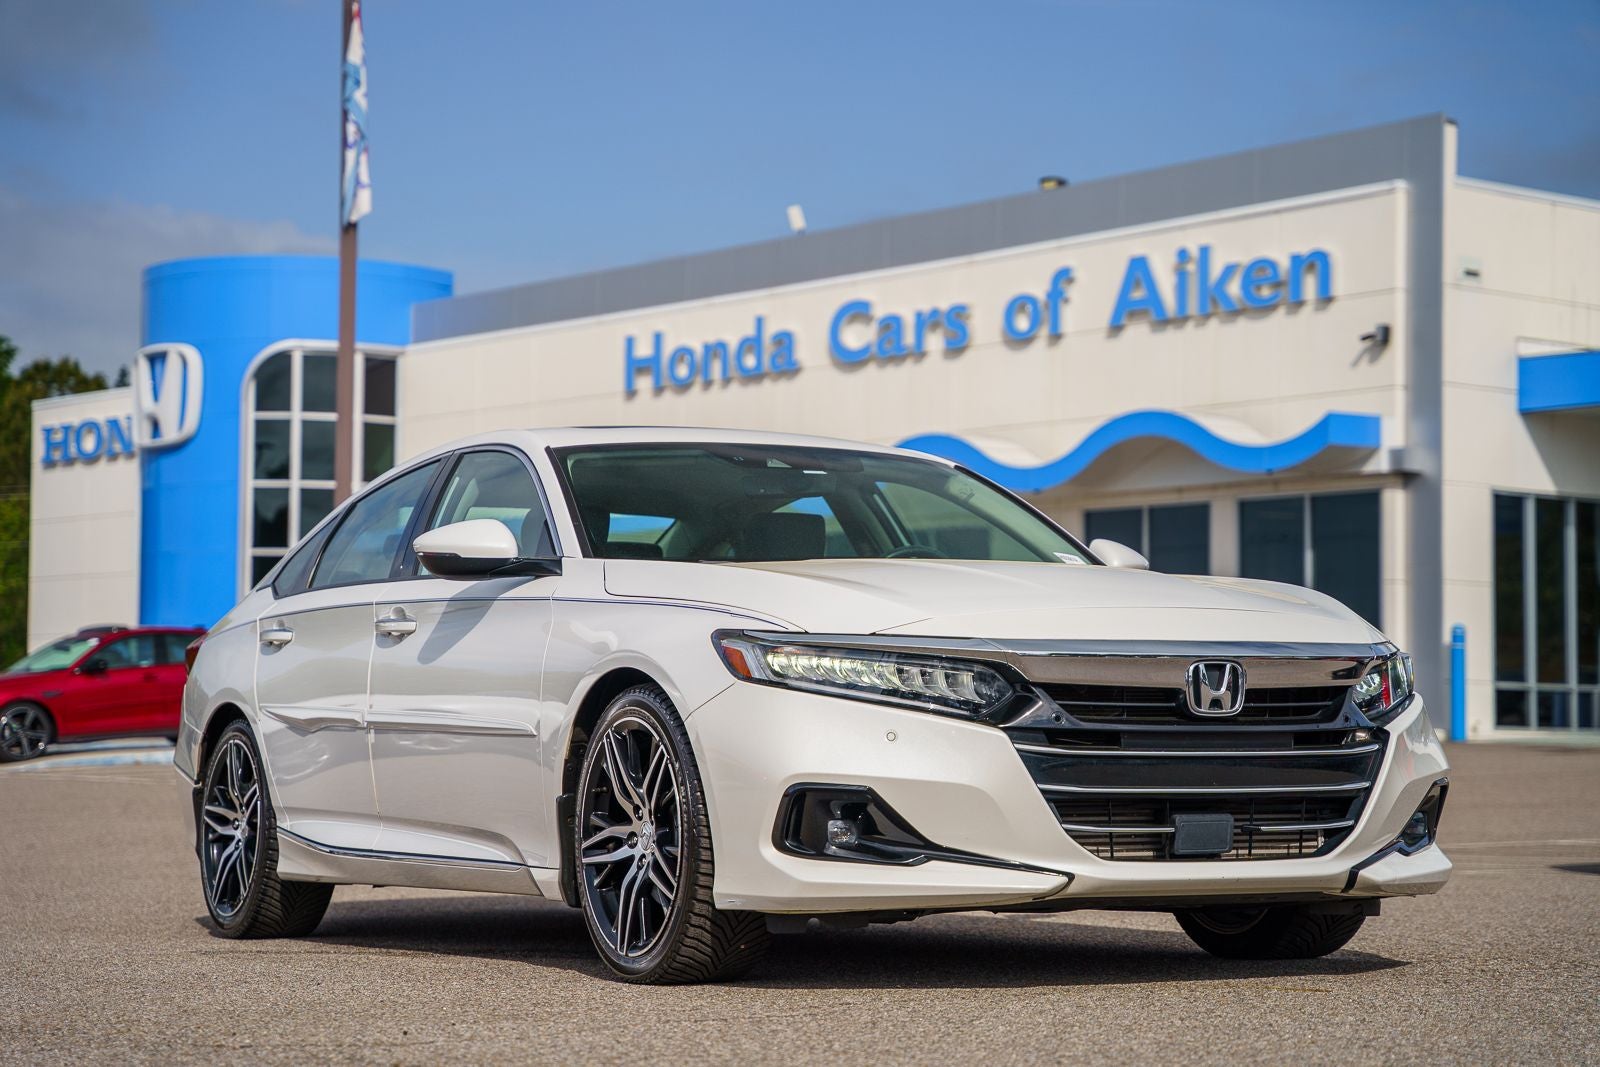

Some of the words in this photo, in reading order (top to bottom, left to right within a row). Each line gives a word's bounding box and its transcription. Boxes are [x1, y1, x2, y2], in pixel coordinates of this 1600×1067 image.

[624, 315, 799, 393] Honda
[828, 299, 971, 364] Cars
[1003, 266, 1074, 341] of
[1108, 244, 1333, 328] Aiken
